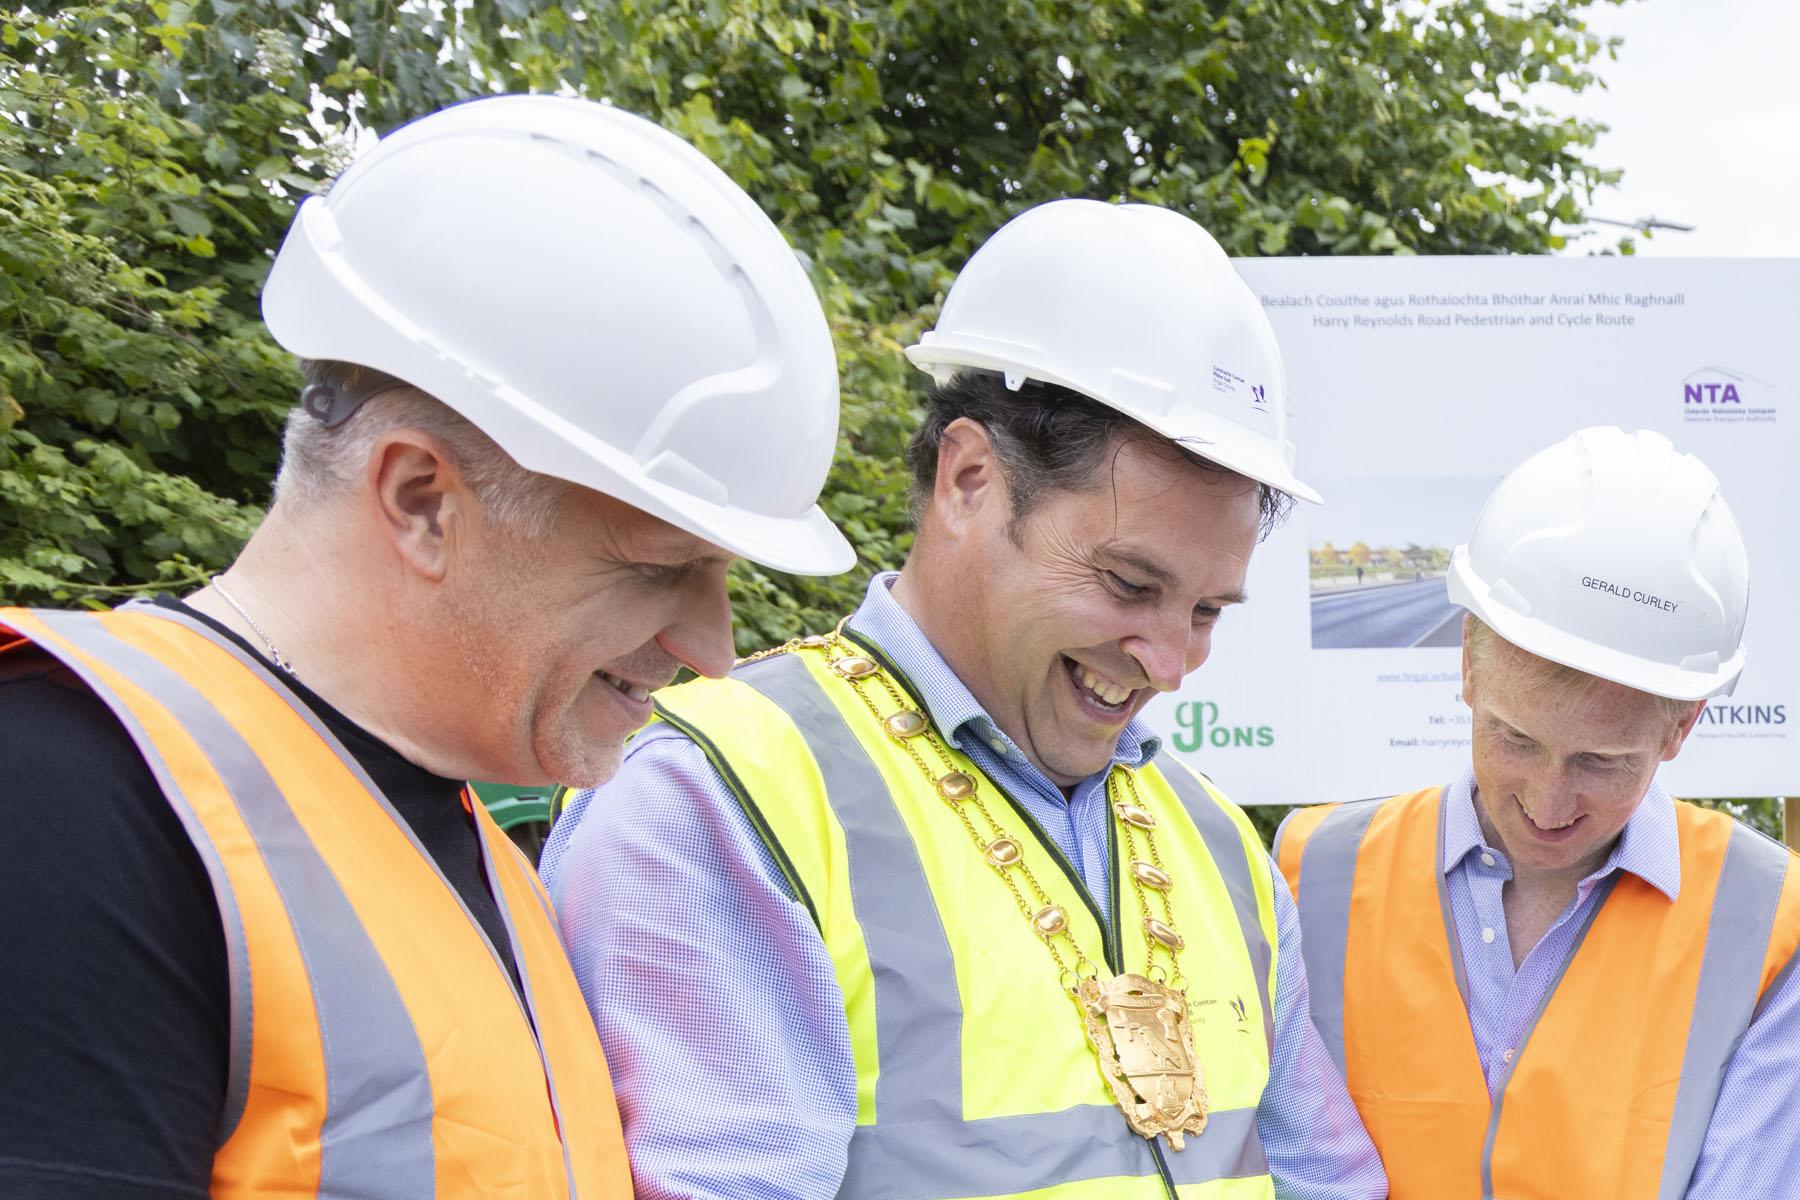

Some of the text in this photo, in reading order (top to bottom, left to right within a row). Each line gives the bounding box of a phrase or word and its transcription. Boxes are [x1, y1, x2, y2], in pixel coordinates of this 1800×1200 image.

[1261, 294, 1312, 307] Bealach
[1317, 293, 1369, 307] Coisithe
[1374, 297, 1404, 309] agus
[1588, 292, 1620, 306] Mhic
[1625, 292, 1685, 308] Raghnaill
[1312, 312, 1635, 328] Harry Reynolds Road Pedestrian and Cycle Route
[1684, 383, 1741, 404] NTA
[1581, 576, 1679, 613] GERALD CURLEY
[1698, 704, 1786, 725] ATKINS
[1390, 737, 1419, 747] Email:
